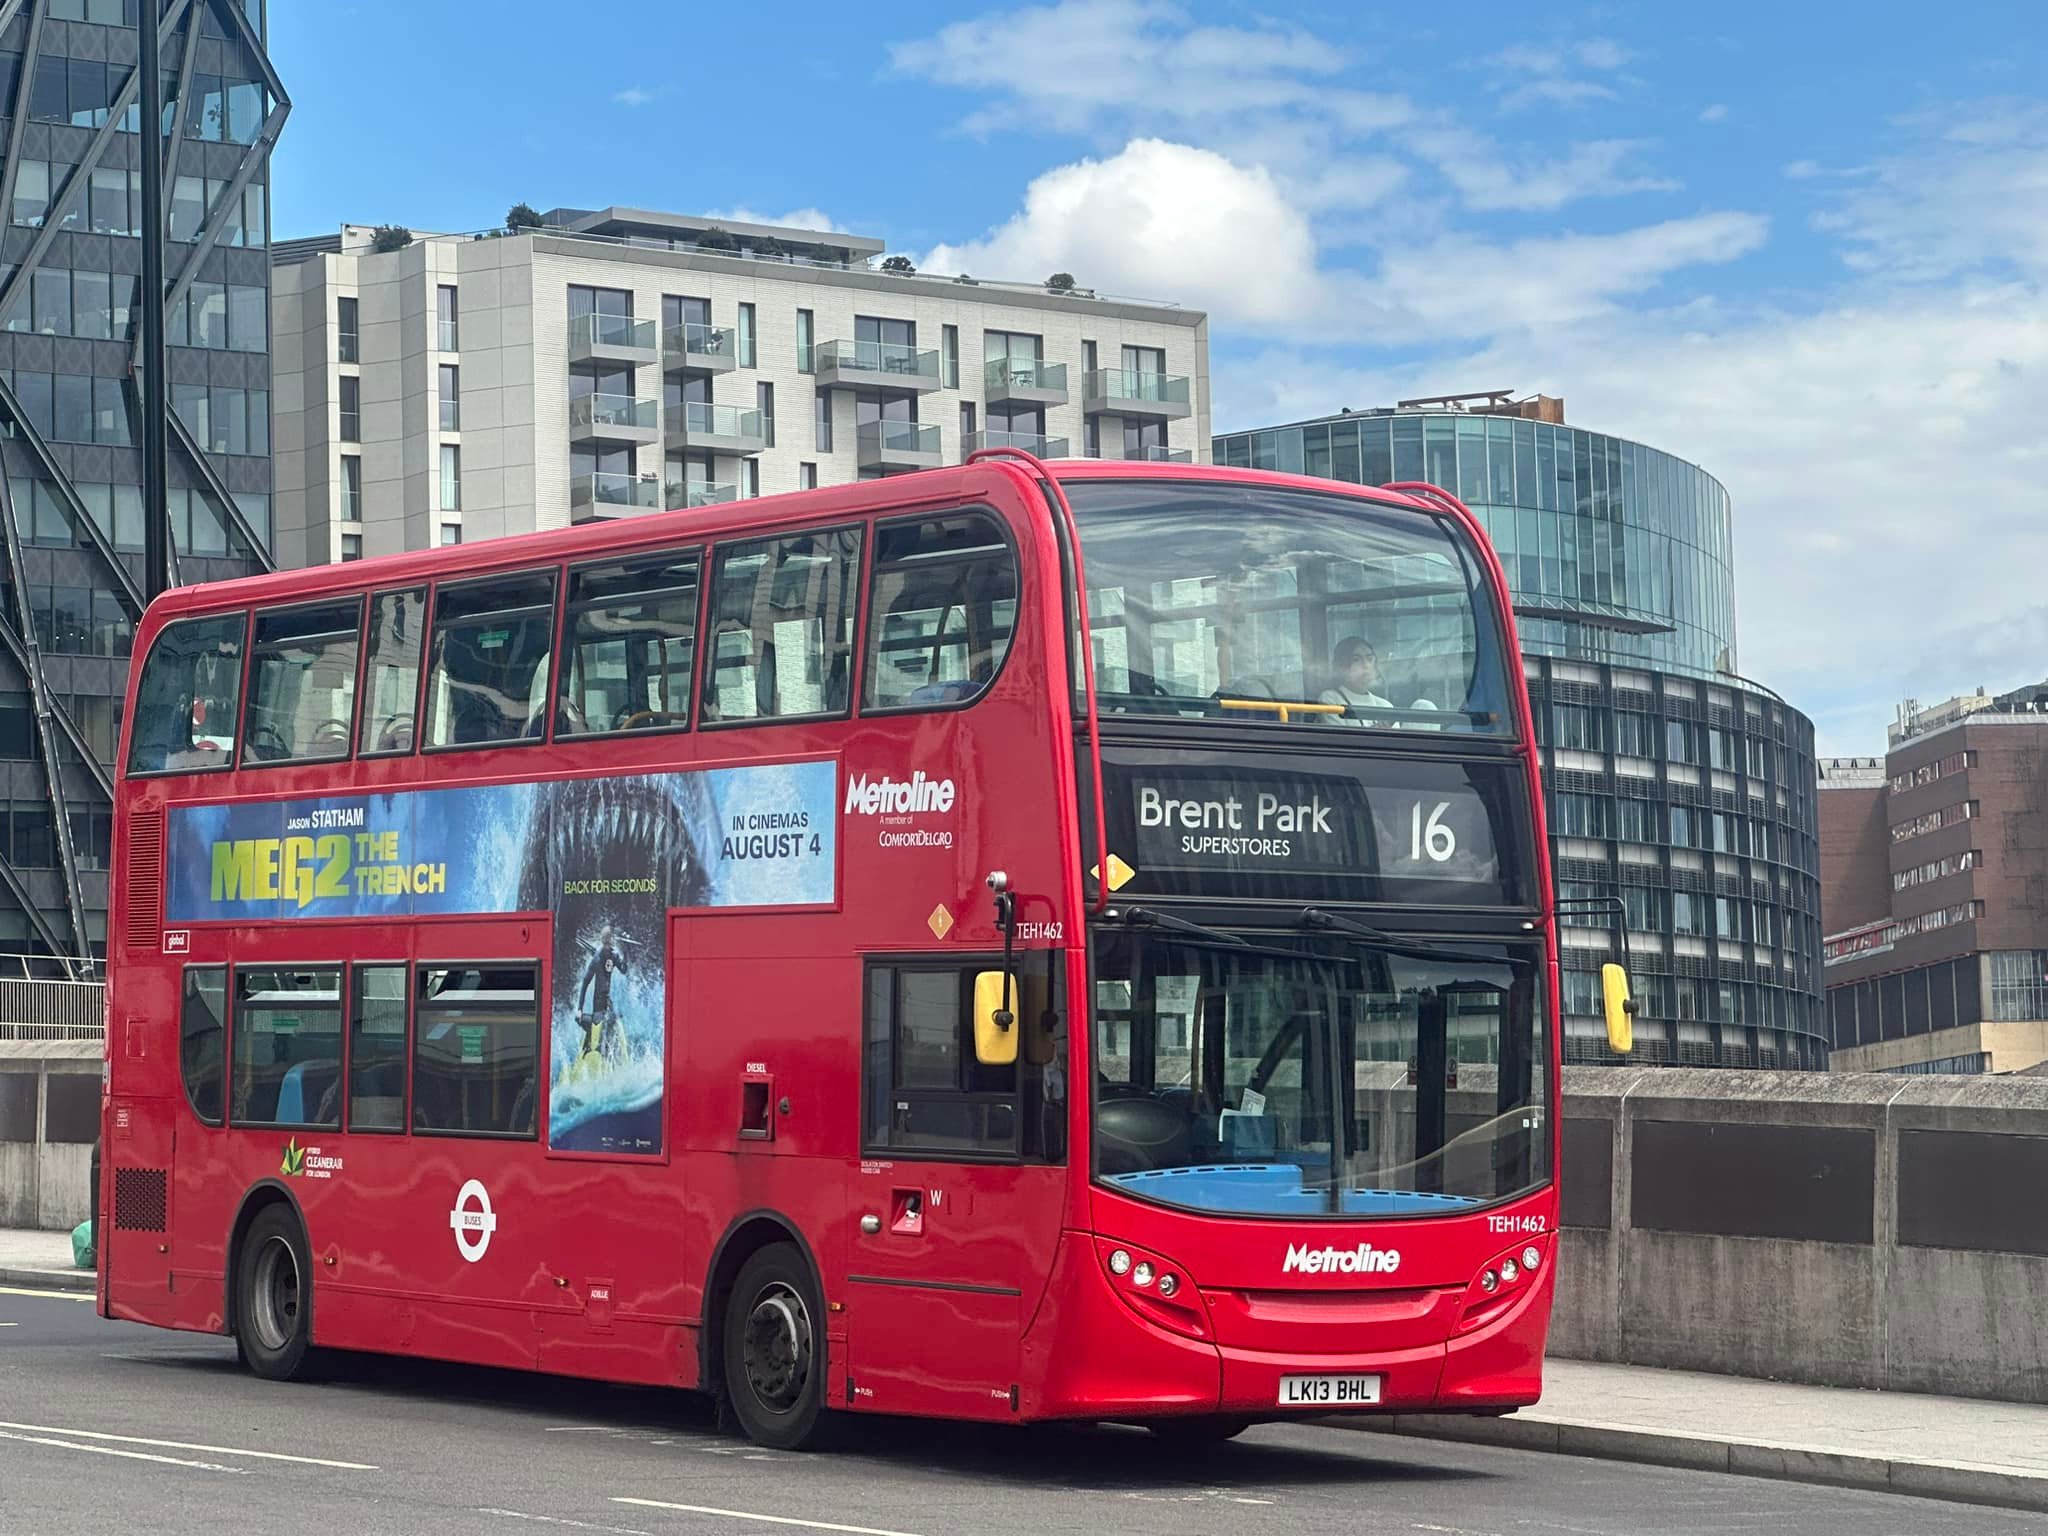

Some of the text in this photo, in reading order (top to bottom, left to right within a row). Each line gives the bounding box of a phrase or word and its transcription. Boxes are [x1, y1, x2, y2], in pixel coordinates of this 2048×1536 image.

[844, 771, 955, 815] Metroline
[287, 808, 364, 830] JASON STATHAM
[1140, 787, 1332, 833] Brent Park
[732, 812, 808, 831] IN CINEMAS
[1411, 800, 1456, 862] 16
[354, 831, 399, 862] THE
[720, 833, 821, 860] AUGUST 4
[1181, 835, 1290, 857] SUPERSTORES
[354, 863, 446, 896] TRENCH
[564, 878, 656, 894] BACK FOR SECONDS
[1016, 922, 1063, 939] TEH1462
[168, 934, 185, 950] global
[746, 1062, 767, 1073] DIESEL
[930, 1190, 942, 1206] W
[464, 1216, 481, 1226] BUSES
[1488, 1215, 1546, 1233] TEH1462
[1282, 1243, 1401, 1274] Metroline
[1288, 1380, 1371, 1400] LK13 BHL
